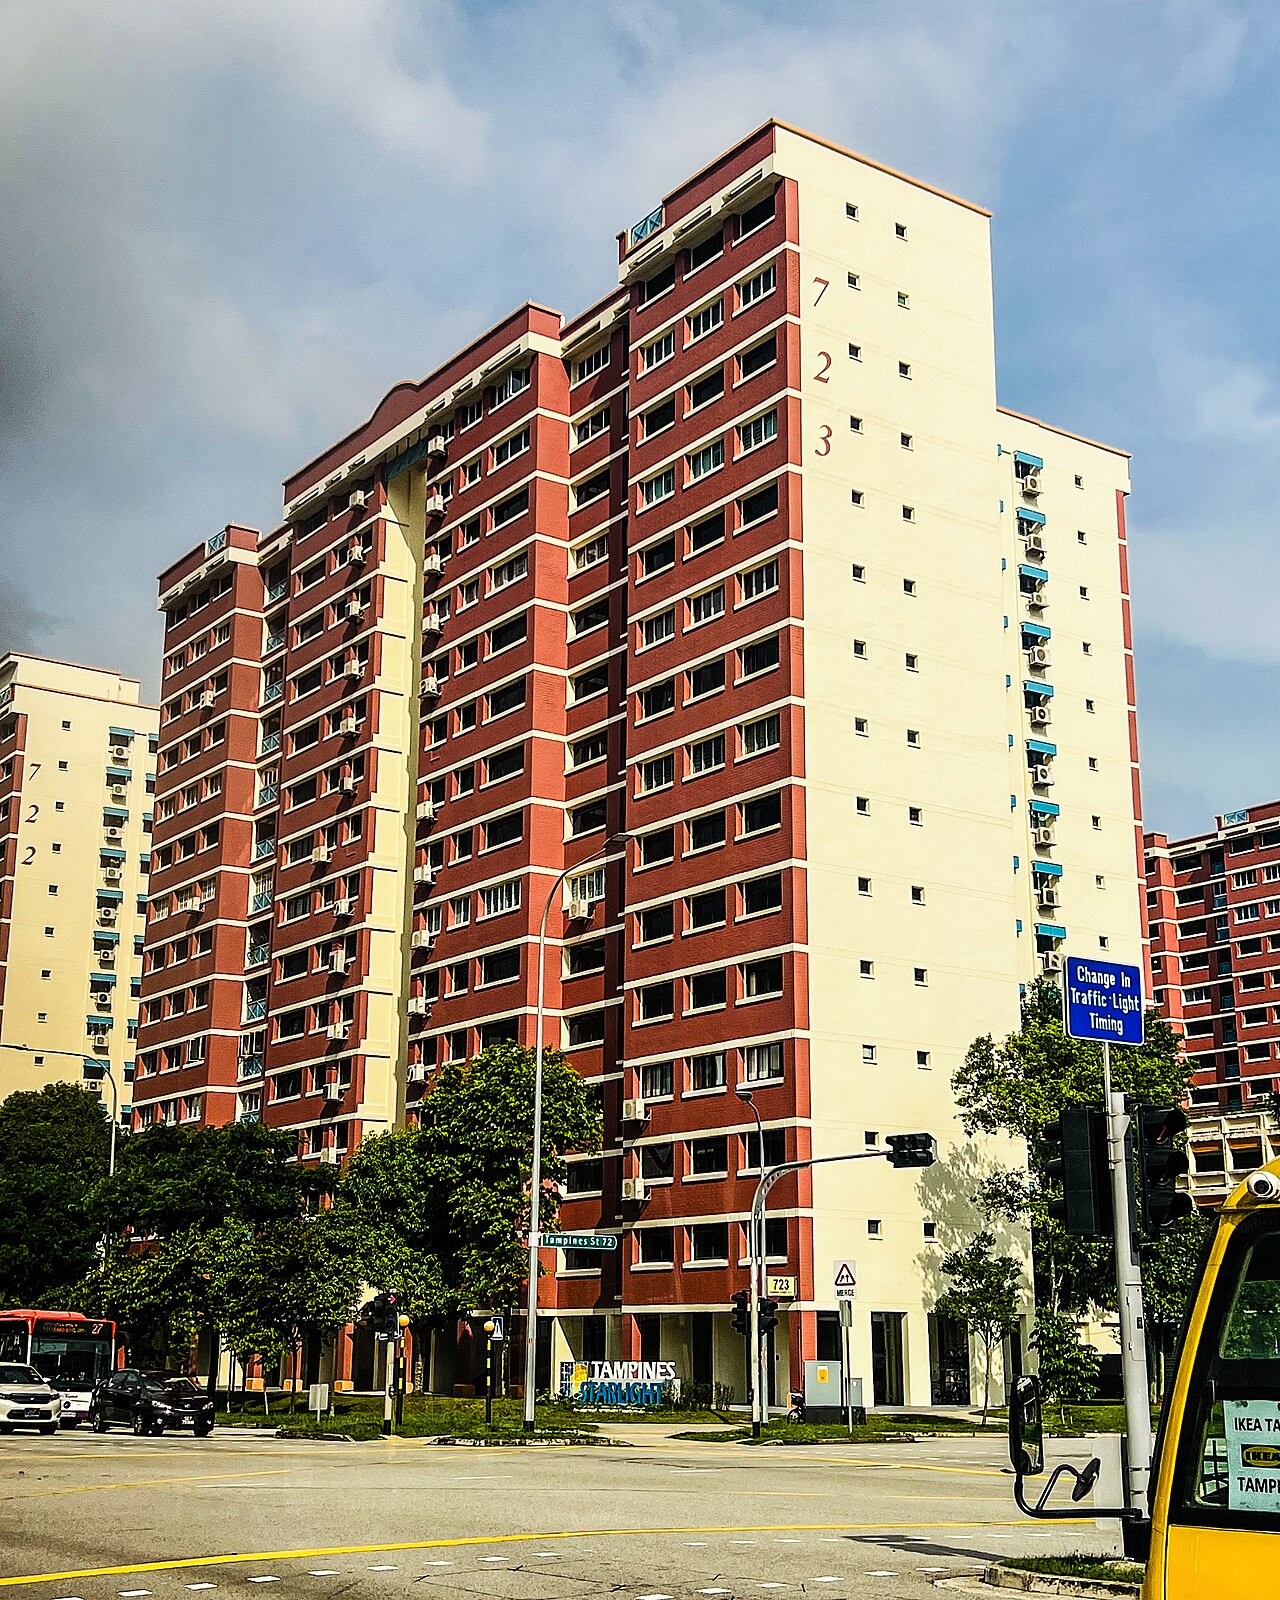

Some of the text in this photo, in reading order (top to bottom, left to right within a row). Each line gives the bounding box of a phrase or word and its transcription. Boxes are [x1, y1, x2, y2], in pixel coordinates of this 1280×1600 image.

[1077, 965, 1131, 989] Change In
[1070, 987, 1140, 1014] Traffic Light
[1089, 1012, 1124, 1036] Timing
[545, 1234, 613, 1247] Tampines St 72
[773, 1279, 790, 1290] 723
[836, 1289, 854, 1297] MERGE
[91, 1323, 104, 1334] 27
[591, 1361, 676, 1380] TAMPINES
[579, 1381, 664, 1405] STARLIGHT
[1234, 1417, 1262, 1431] IKEA
[1245, 1450, 1280, 1461] IKEA
